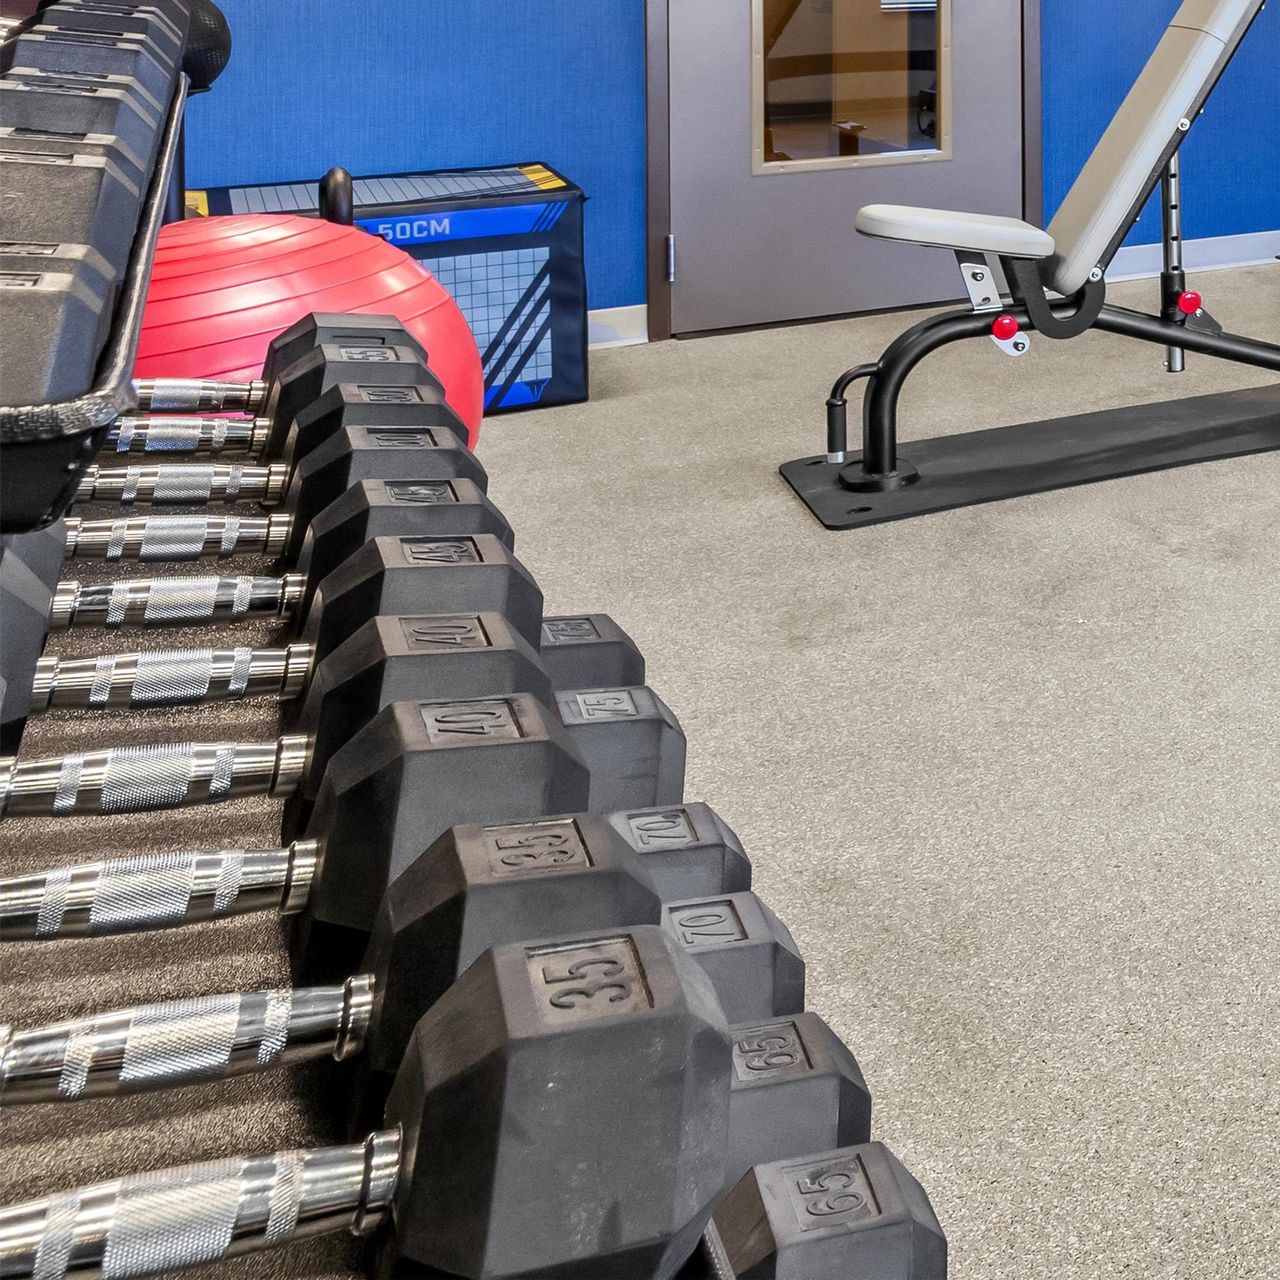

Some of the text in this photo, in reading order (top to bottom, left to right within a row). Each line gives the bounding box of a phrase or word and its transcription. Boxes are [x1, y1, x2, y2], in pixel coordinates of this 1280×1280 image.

[378, 218, 450, 240] 50CM
[409, 543, 470, 563] 45
[412, 625, 477, 645] 40
[583, 697, 629, 717] 75
[434, 711, 507, 735] 40
[636, 820, 688, 844] 70
[495, 834, 575, 867] 35
[679, 914, 737, 944] 70
[542, 958, 633, 1010] 35
[737, 1035, 800, 1071] 65
[797, 1173, 864, 1217] 65
